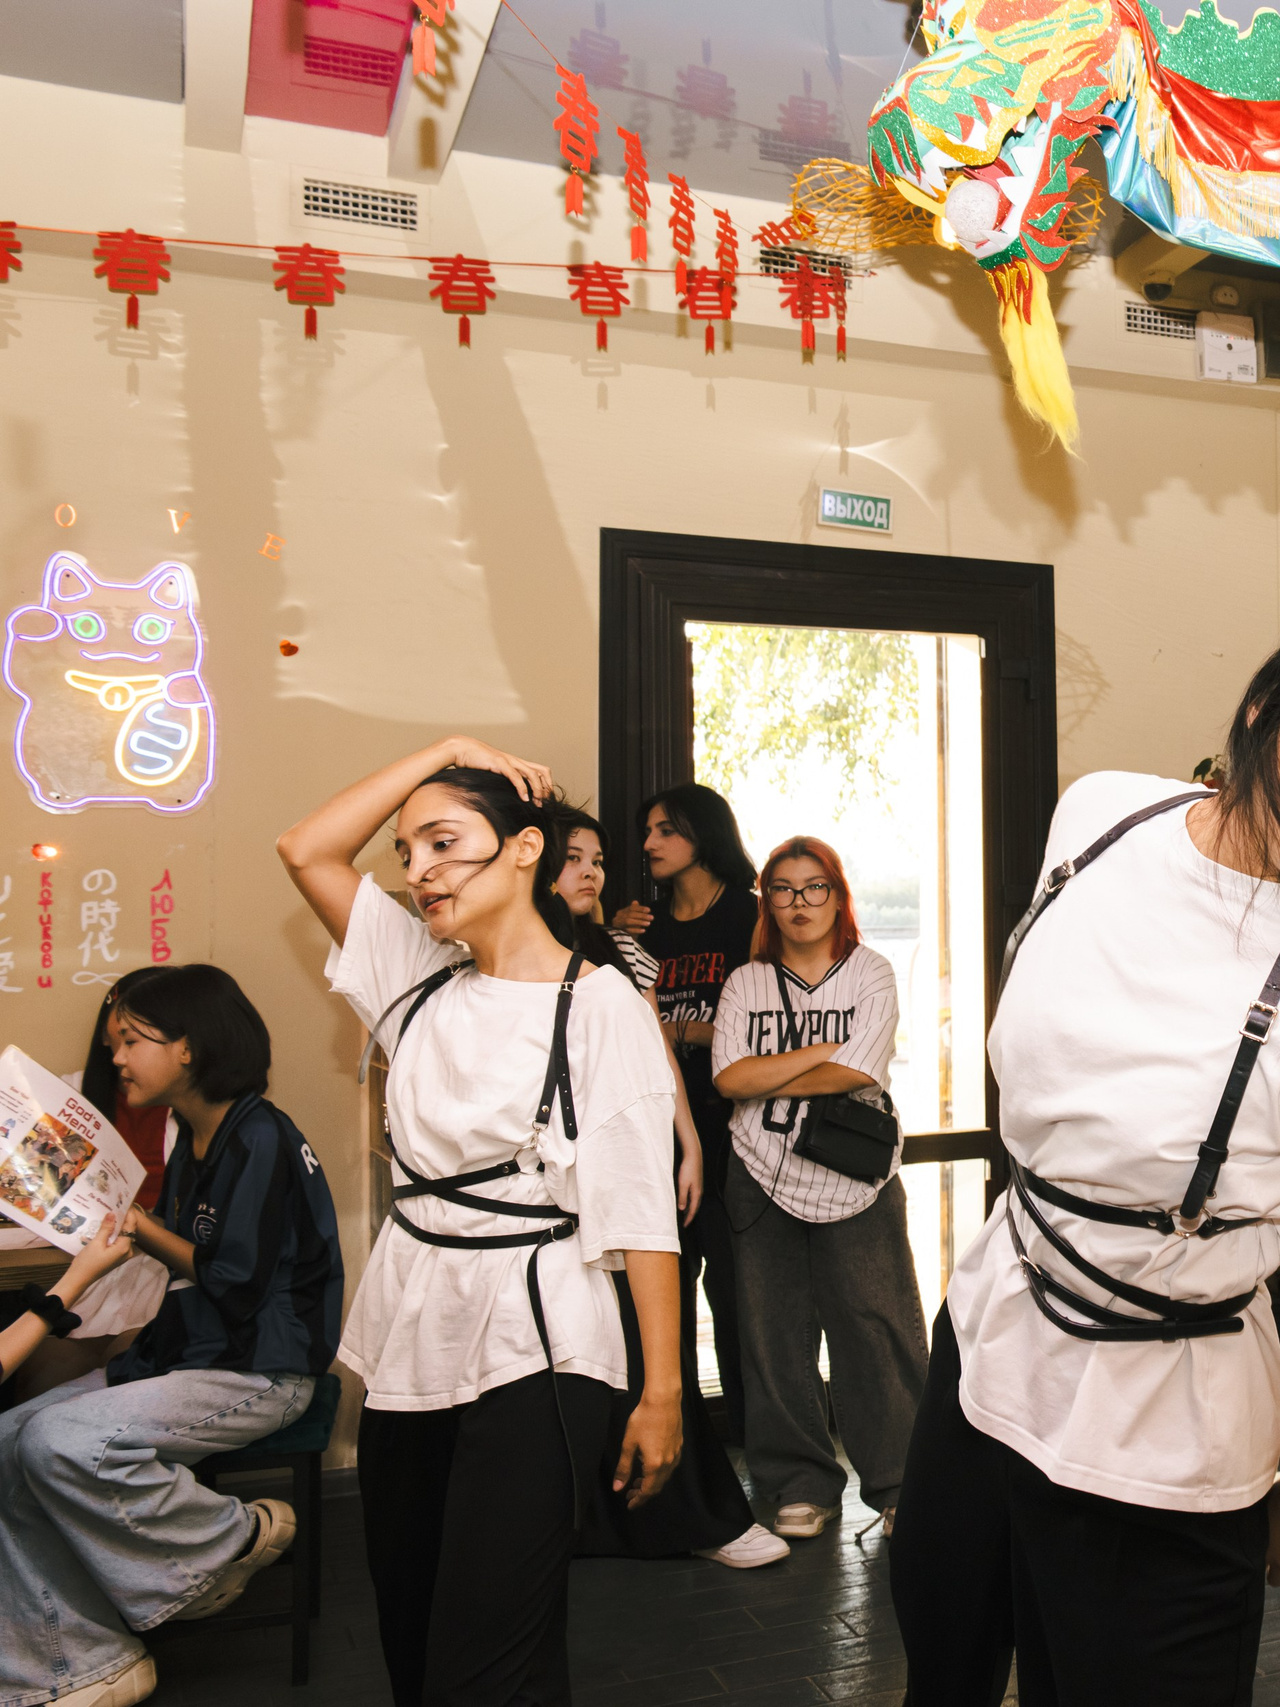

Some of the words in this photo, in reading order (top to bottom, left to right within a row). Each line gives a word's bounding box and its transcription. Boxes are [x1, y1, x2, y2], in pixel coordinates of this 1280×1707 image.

[94, 228, 172, 295] 春
[273, 243, 346, 305] 春
[428, 254, 497, 314] 春
[567, 261, 630, 317] 春
[824, 493, 888, 528] ВЫХОД
[151, 868, 174, 963] ЛЮБВ
[57, 1108, 96, 1140] Menu
[65, 1097, 102, 1131] God's
[301, 1143, 319, 1175] R
